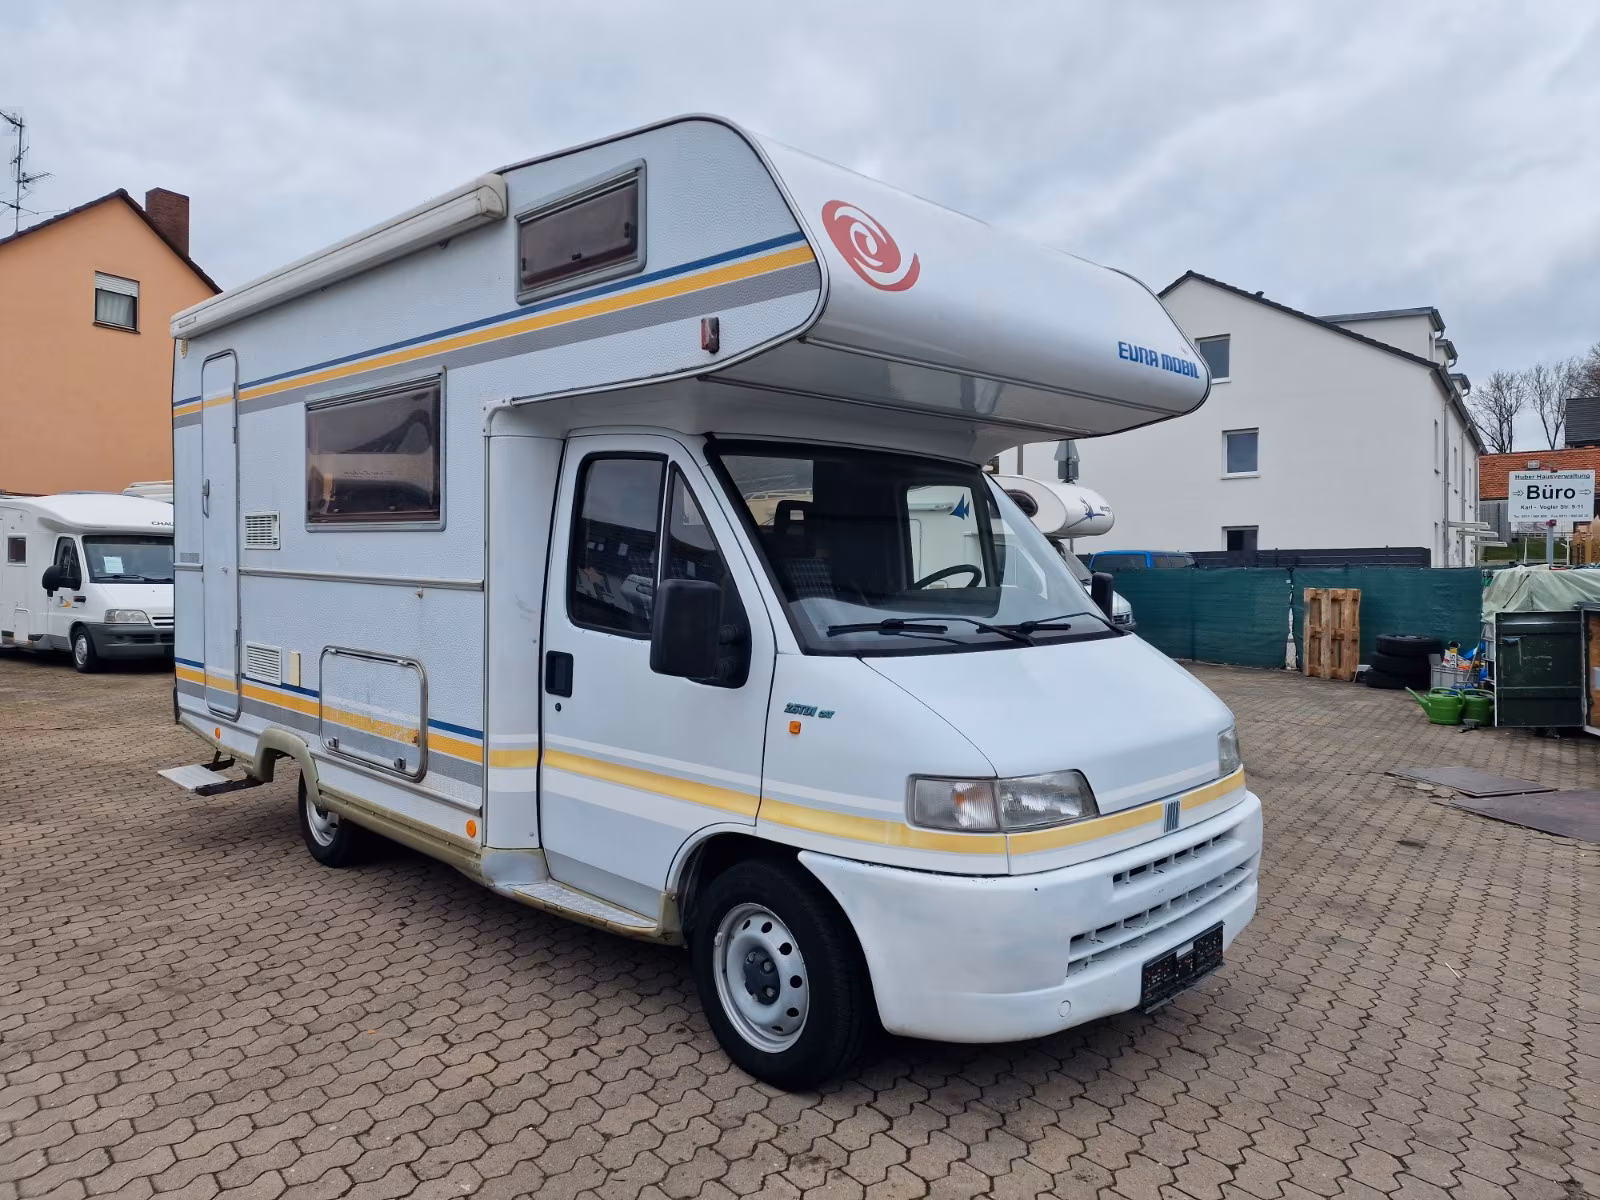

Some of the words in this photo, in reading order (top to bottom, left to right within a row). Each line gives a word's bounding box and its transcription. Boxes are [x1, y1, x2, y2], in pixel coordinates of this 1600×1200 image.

[1118, 341, 1158, 367] EURA
[1161, 354, 1200, 378] MOBIL
[1526, 484, 1576, 500] Büro
